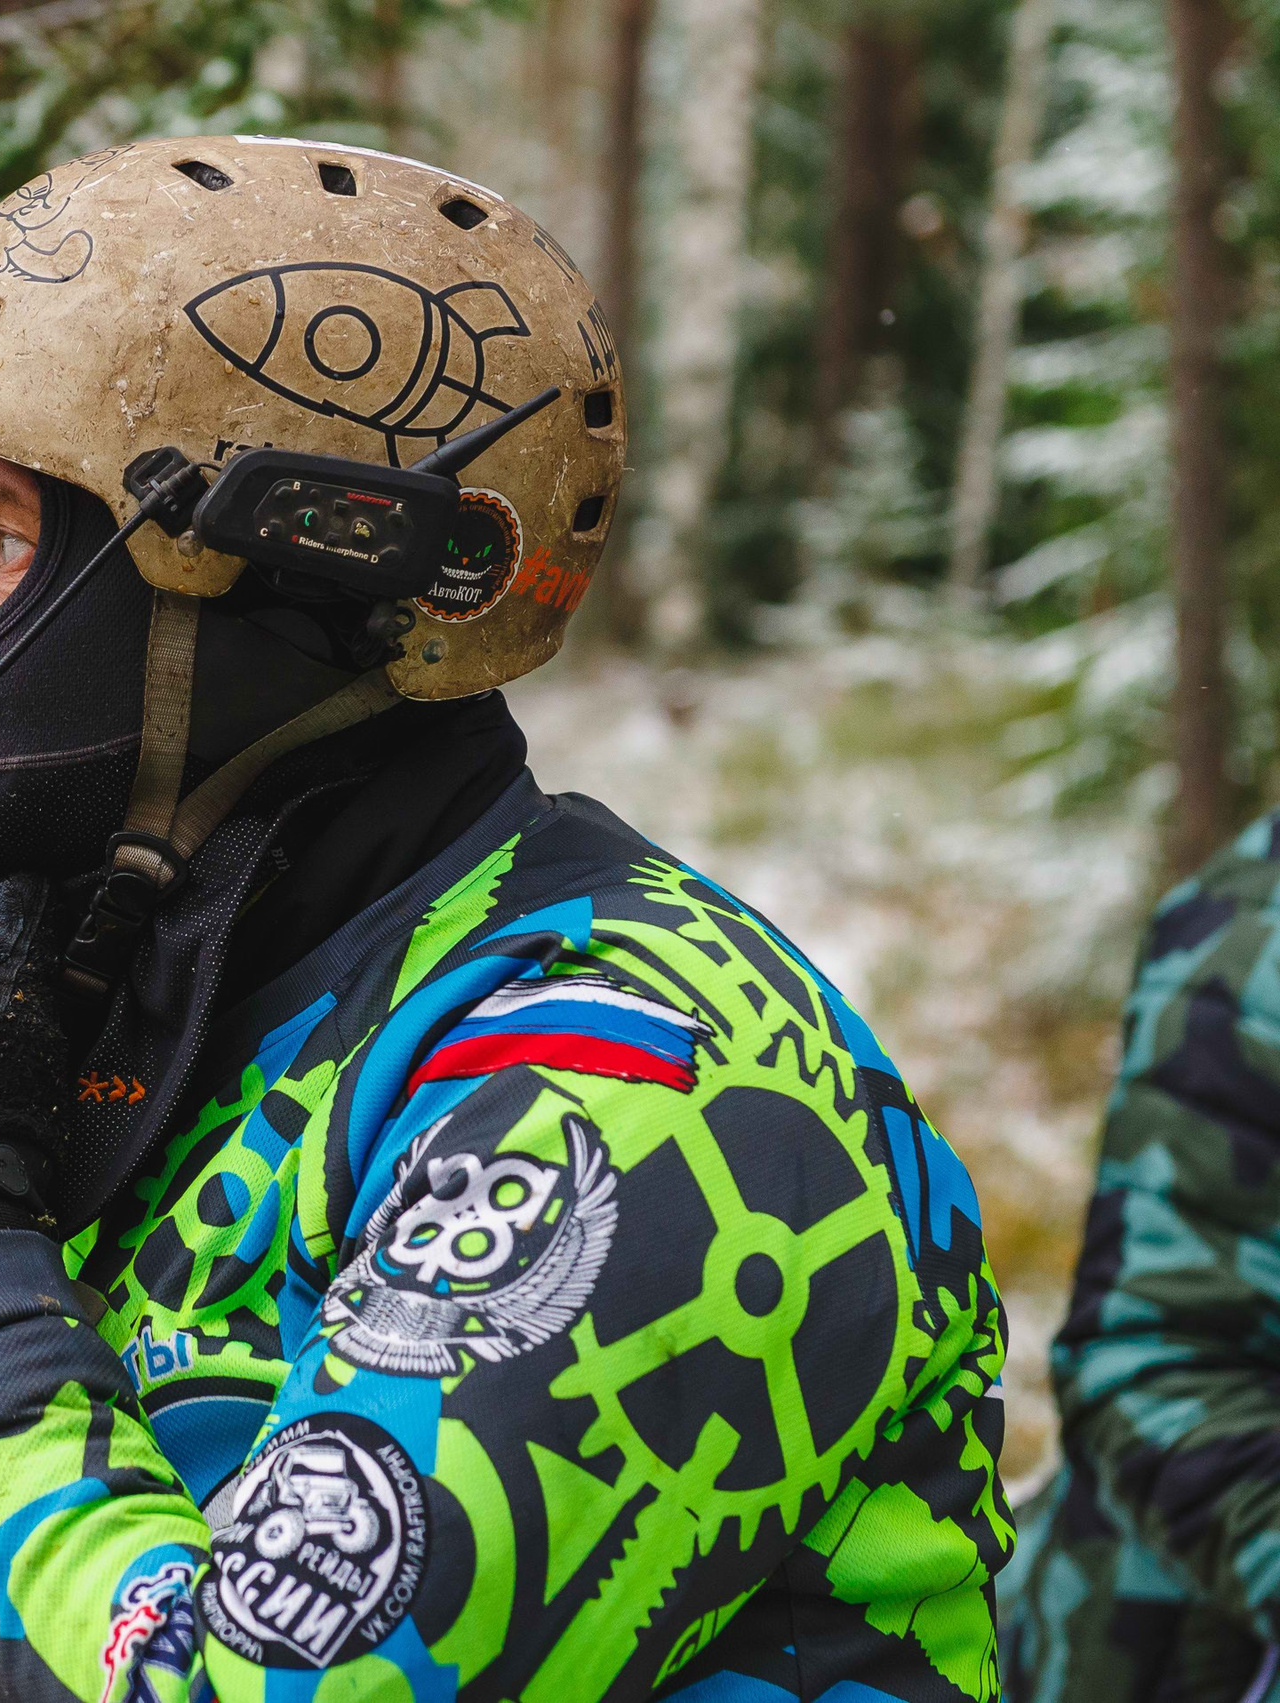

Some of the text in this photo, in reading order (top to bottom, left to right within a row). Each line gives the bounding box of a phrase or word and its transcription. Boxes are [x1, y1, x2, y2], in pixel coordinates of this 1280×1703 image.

[293, 481, 301, 491] B
[396, 503, 403, 512] E
[260, 527, 269, 536] C
[299, 536, 325, 550] Riders
[371, 554, 379, 564] D
[297, 1541, 373, 1598] РЕЙДЫ
[214, 1551, 348, 1655] ССИИ
